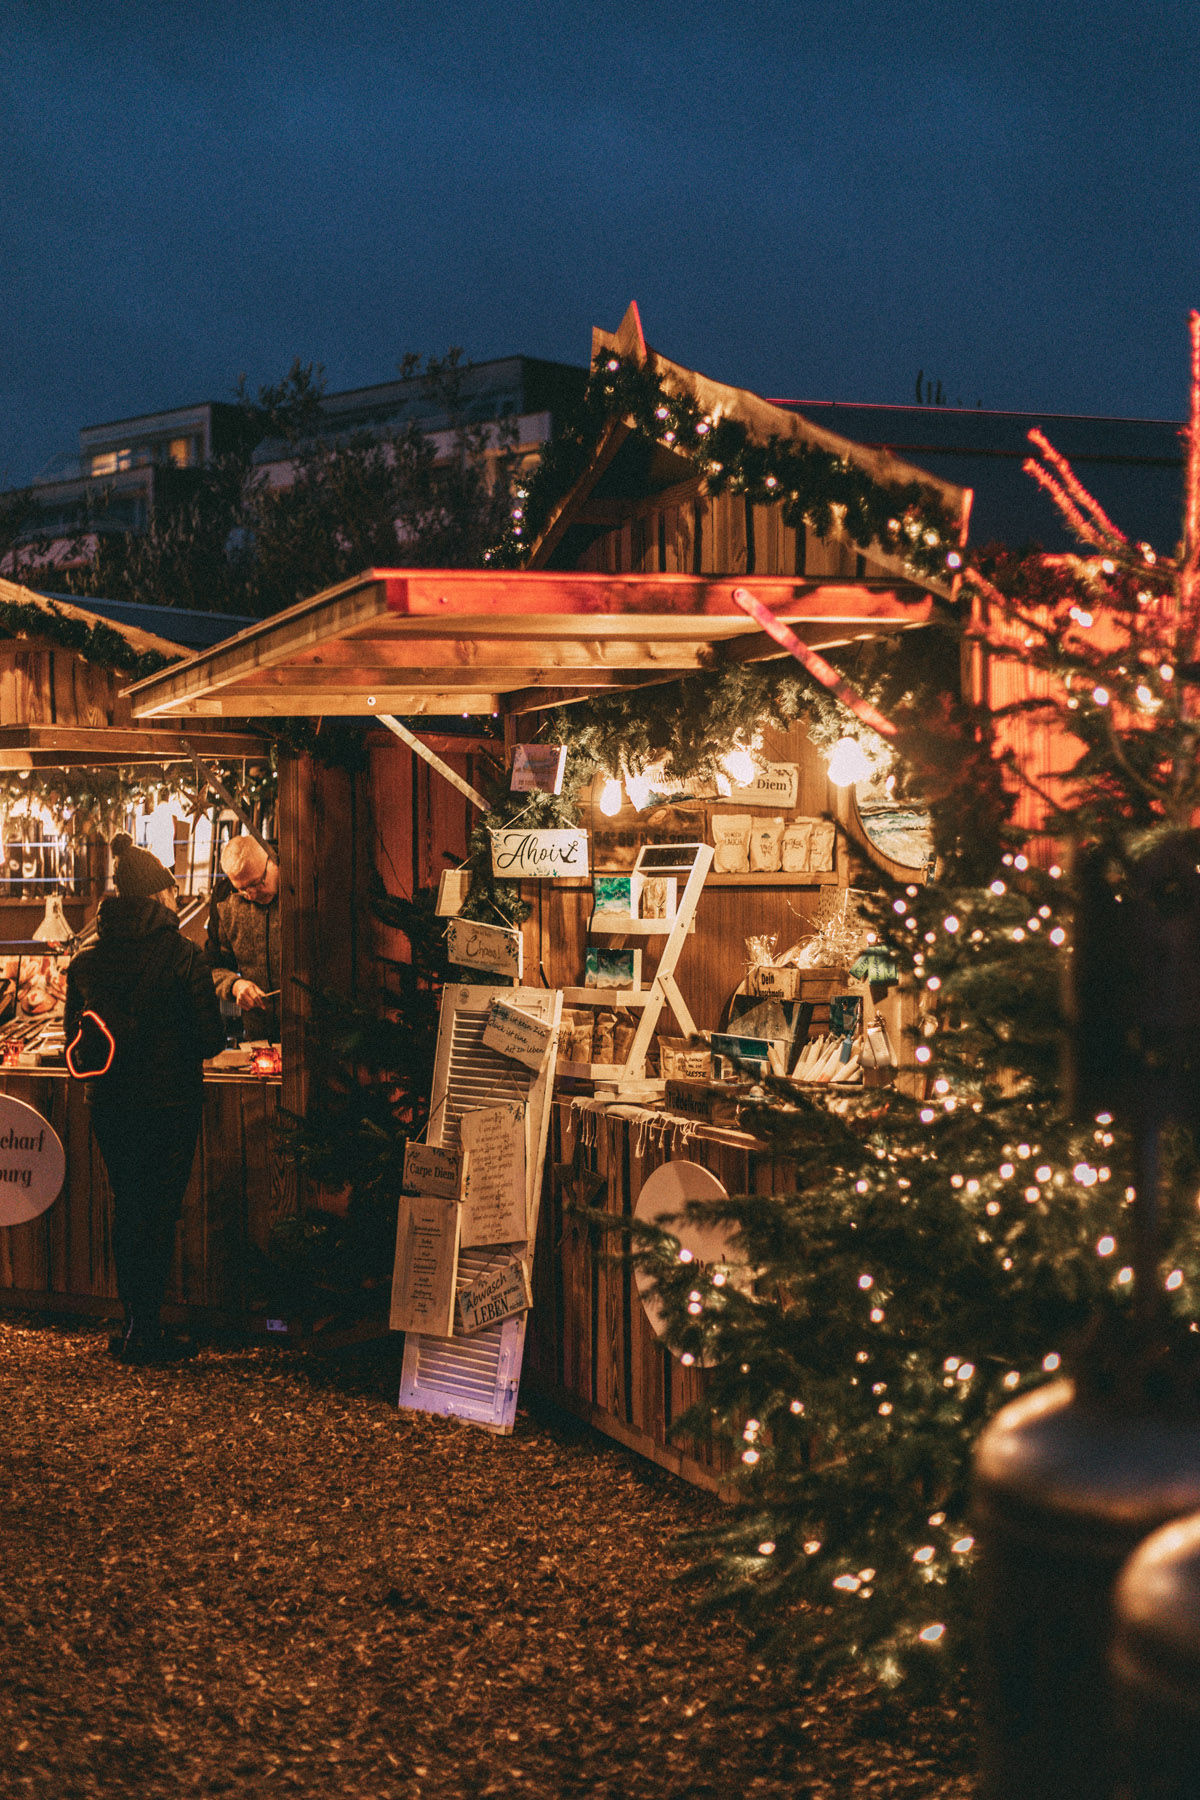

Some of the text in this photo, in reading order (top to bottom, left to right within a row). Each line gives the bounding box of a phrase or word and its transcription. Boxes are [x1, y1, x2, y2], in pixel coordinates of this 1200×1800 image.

[757, 779, 787, 791] Diem
[497, 833, 559, 870] Ahoi
[761, 972, 775, 985] Dein
[0, 1128, 45, 1153] charf
[409, 1162, 455, 1180] Carpe Diem
[466, 1272, 507, 1312] Abwasch
[474, 1297, 509, 1326] LEBEN
